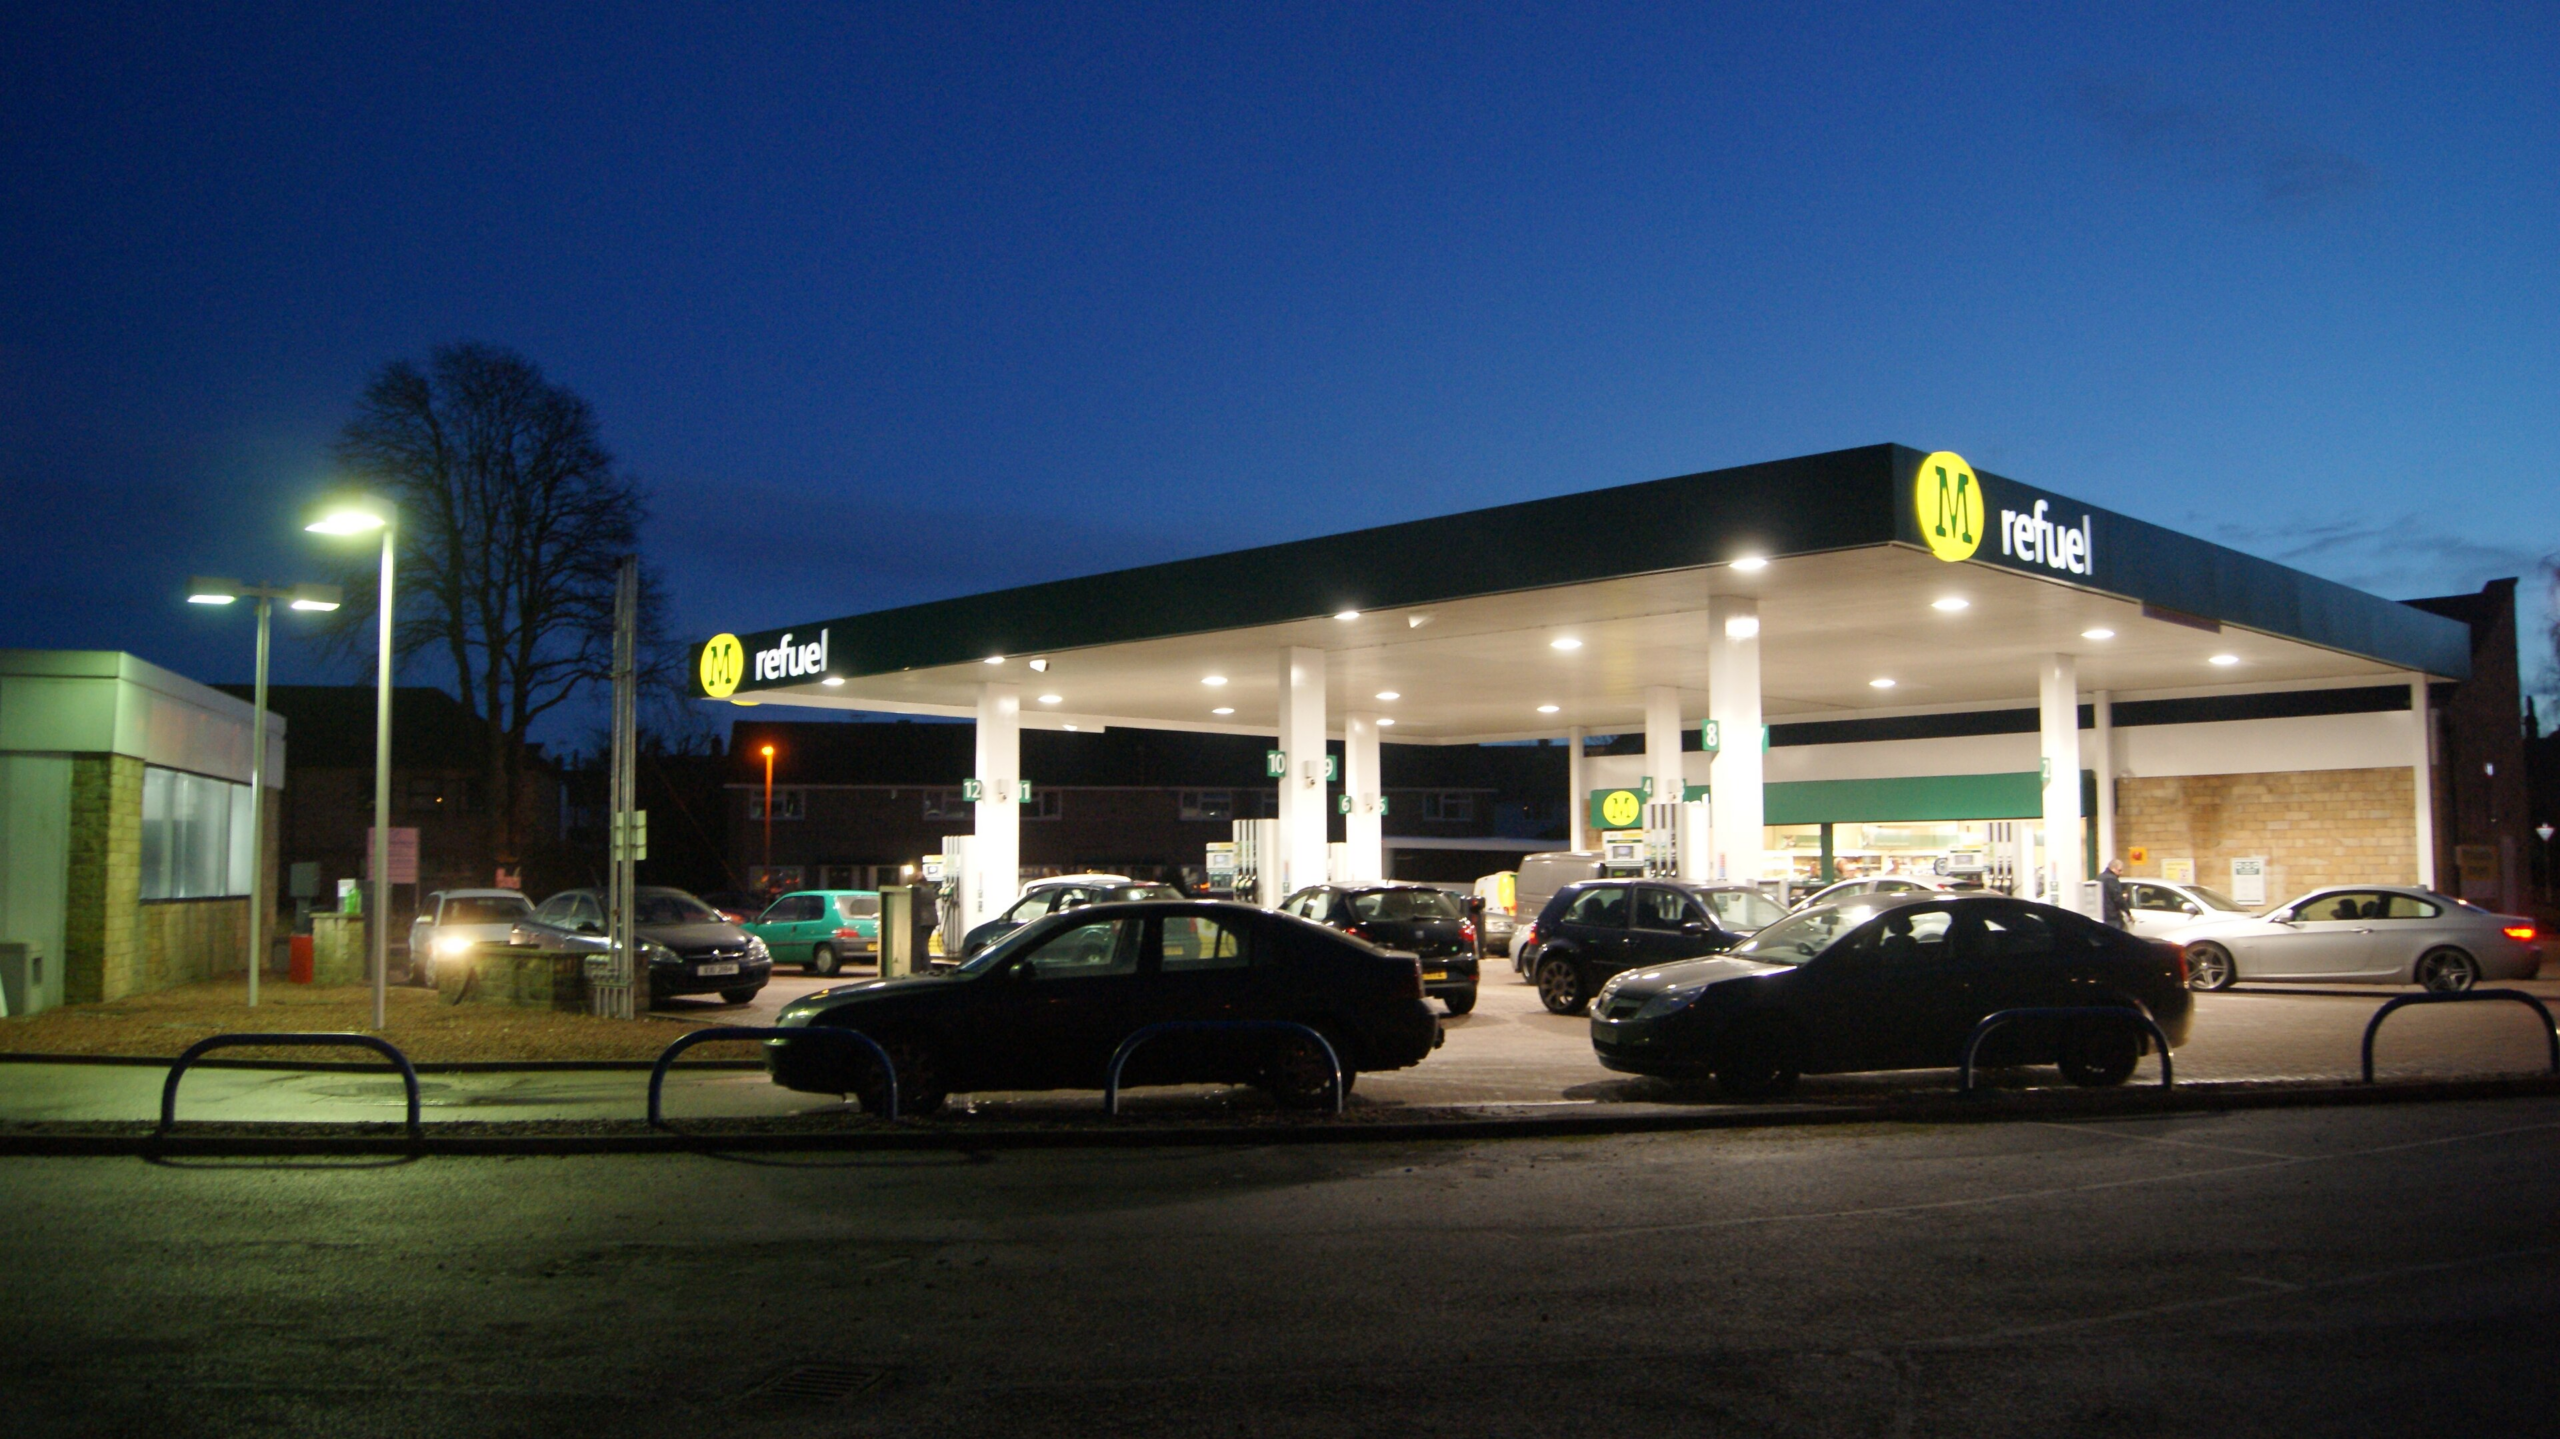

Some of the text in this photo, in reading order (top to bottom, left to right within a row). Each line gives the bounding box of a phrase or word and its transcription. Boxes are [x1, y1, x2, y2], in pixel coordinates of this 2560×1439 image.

[1935, 465, 2093, 576] M refuel
[708, 628, 829, 686] M refuel
[1706, 722, 1718, 747] 8
[1267, 753, 1286, 774] 10
[1324, 758, 1334, 777] 9
[2042, 760, 2051, 778] 2
[963, 781, 982, 799] 12
[1643, 778, 1652, 795] 4
[1341, 797, 1351, 812] 6
